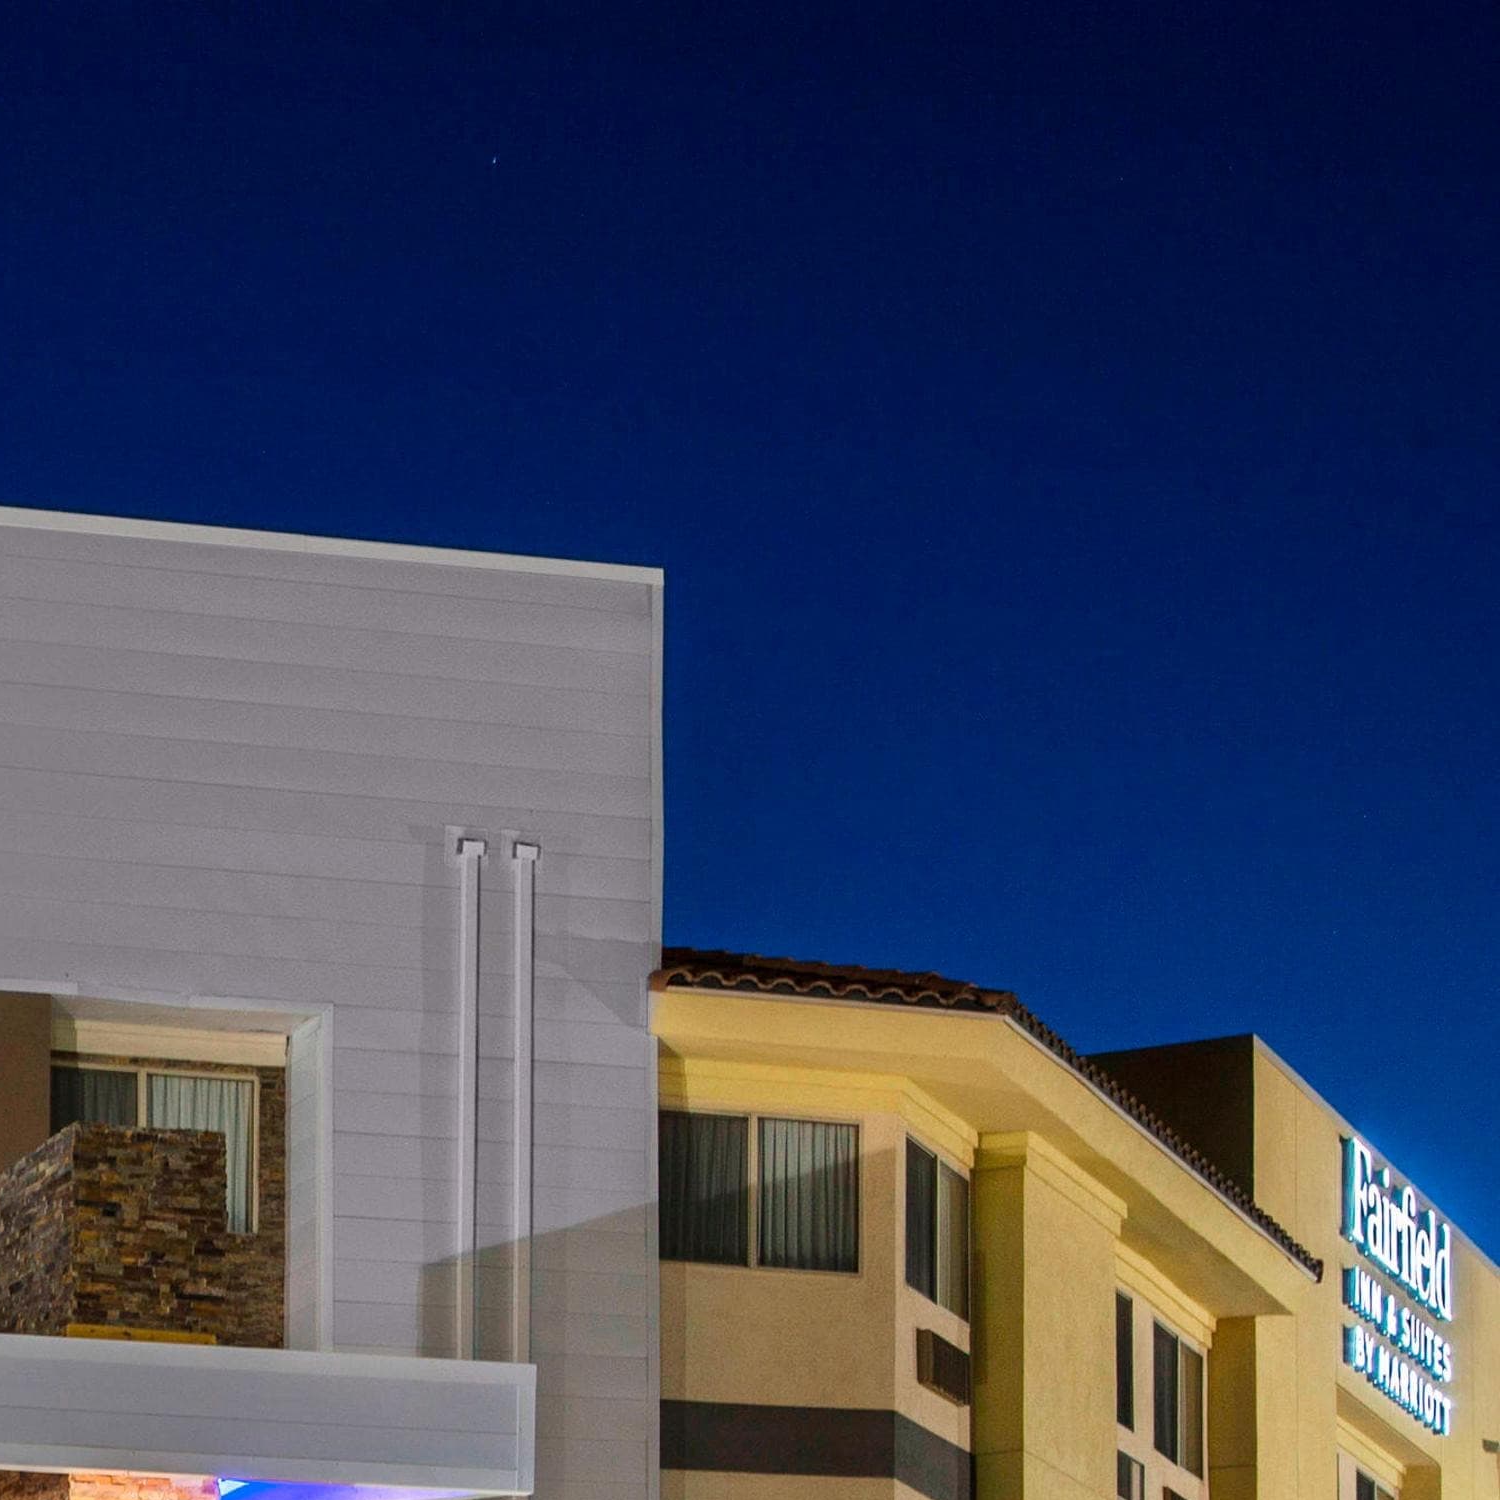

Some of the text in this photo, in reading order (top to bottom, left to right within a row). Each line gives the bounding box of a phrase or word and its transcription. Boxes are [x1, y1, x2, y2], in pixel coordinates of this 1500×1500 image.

[1350, 1136, 1453, 1322] Fairfield
[1353, 1265, 1452, 1383] INN & SUITES
[1353, 1325, 1452, 1437] BY MARRIOTT
